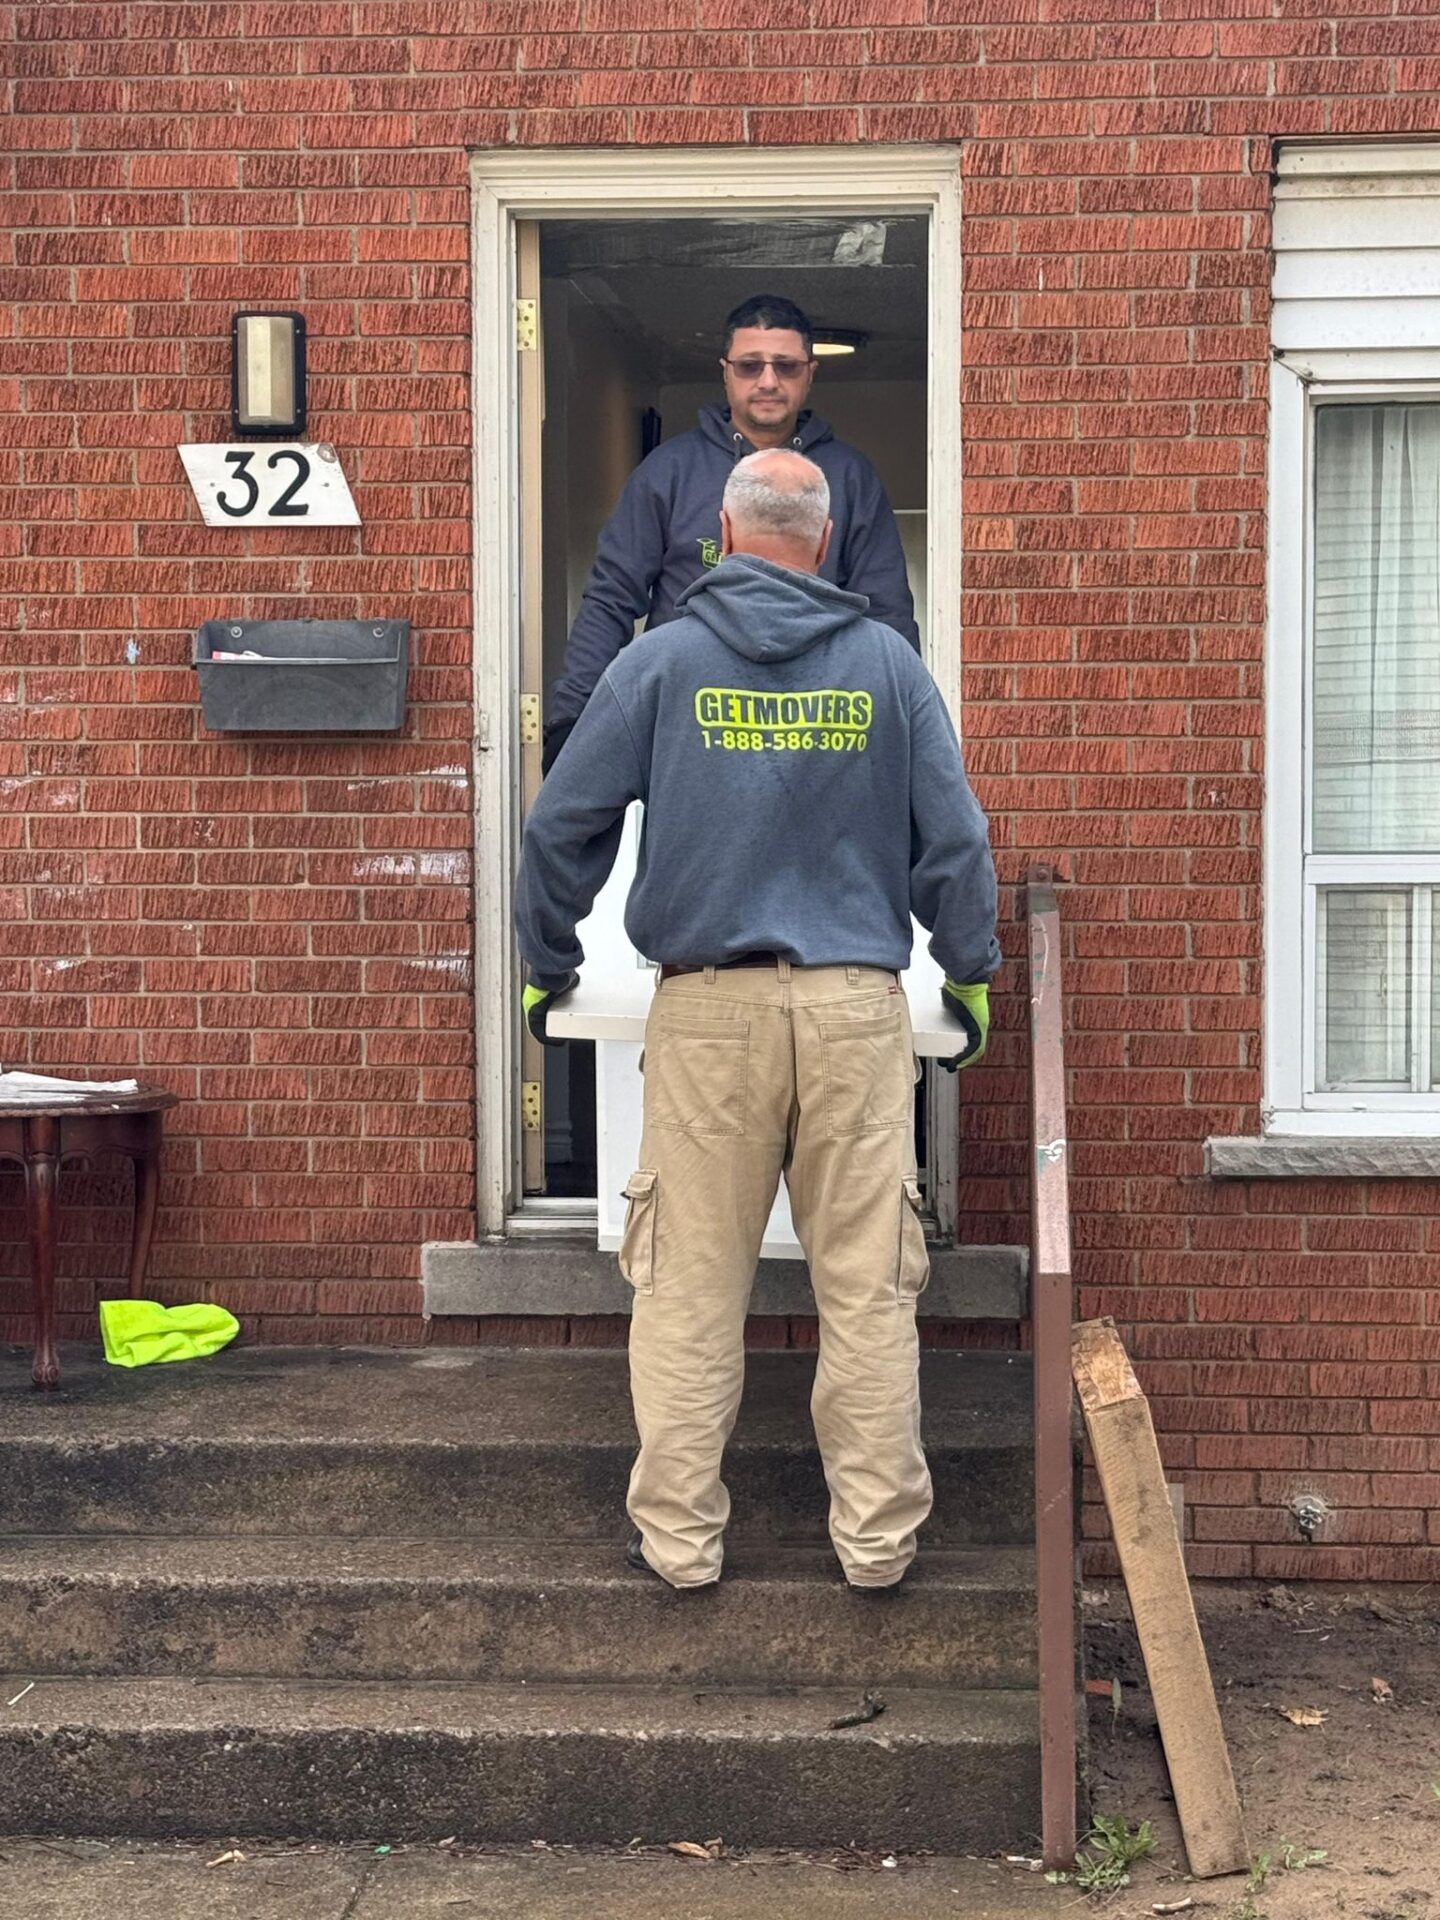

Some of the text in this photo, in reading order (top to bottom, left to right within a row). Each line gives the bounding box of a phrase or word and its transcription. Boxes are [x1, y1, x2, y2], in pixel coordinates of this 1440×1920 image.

[216, 450, 310, 517] 32
[700, 692, 868, 726] GETMOVERS
[701, 730, 867, 752] 1-888-586-3070
